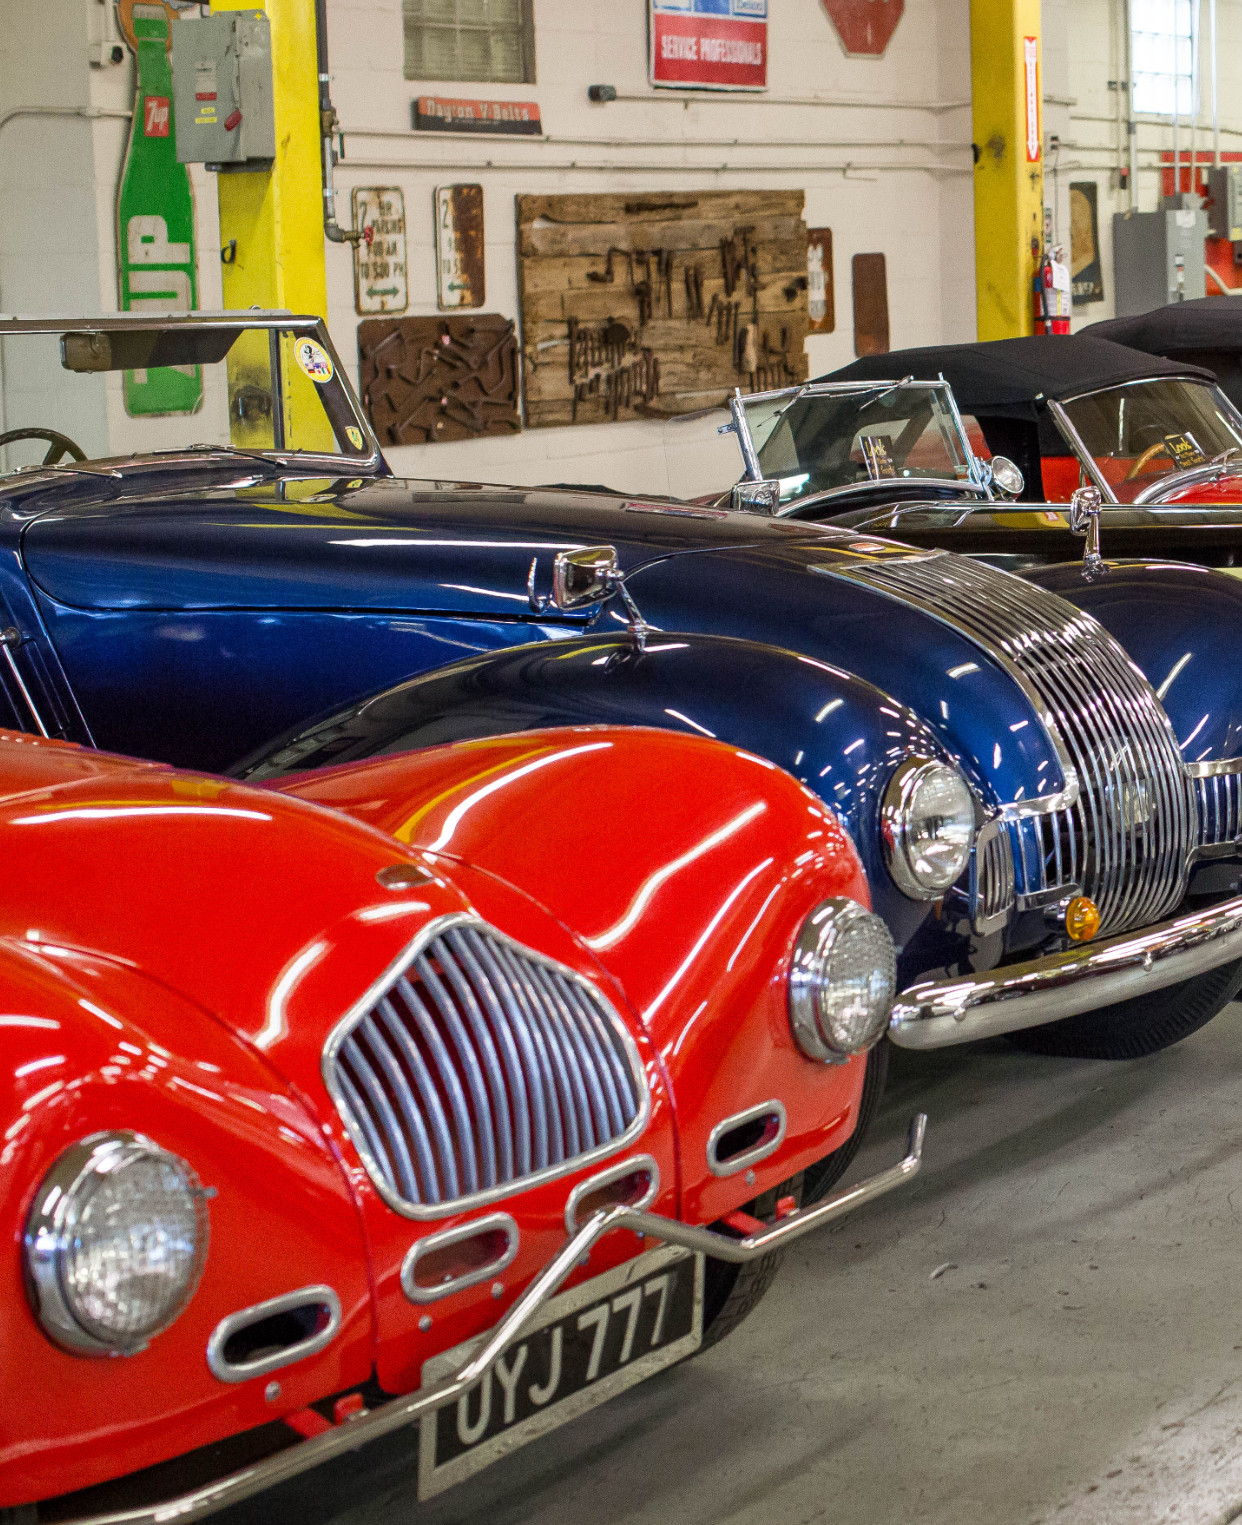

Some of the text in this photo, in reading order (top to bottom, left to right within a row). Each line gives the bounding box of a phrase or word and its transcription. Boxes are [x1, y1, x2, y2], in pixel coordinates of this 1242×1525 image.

[661, 34, 763, 66] SERVICE PROFESSIONALS
[426, 98, 474, 123] Dayton
[1168, 437, 1192, 454] Look
[577, 1270, 671, 1382] 777
